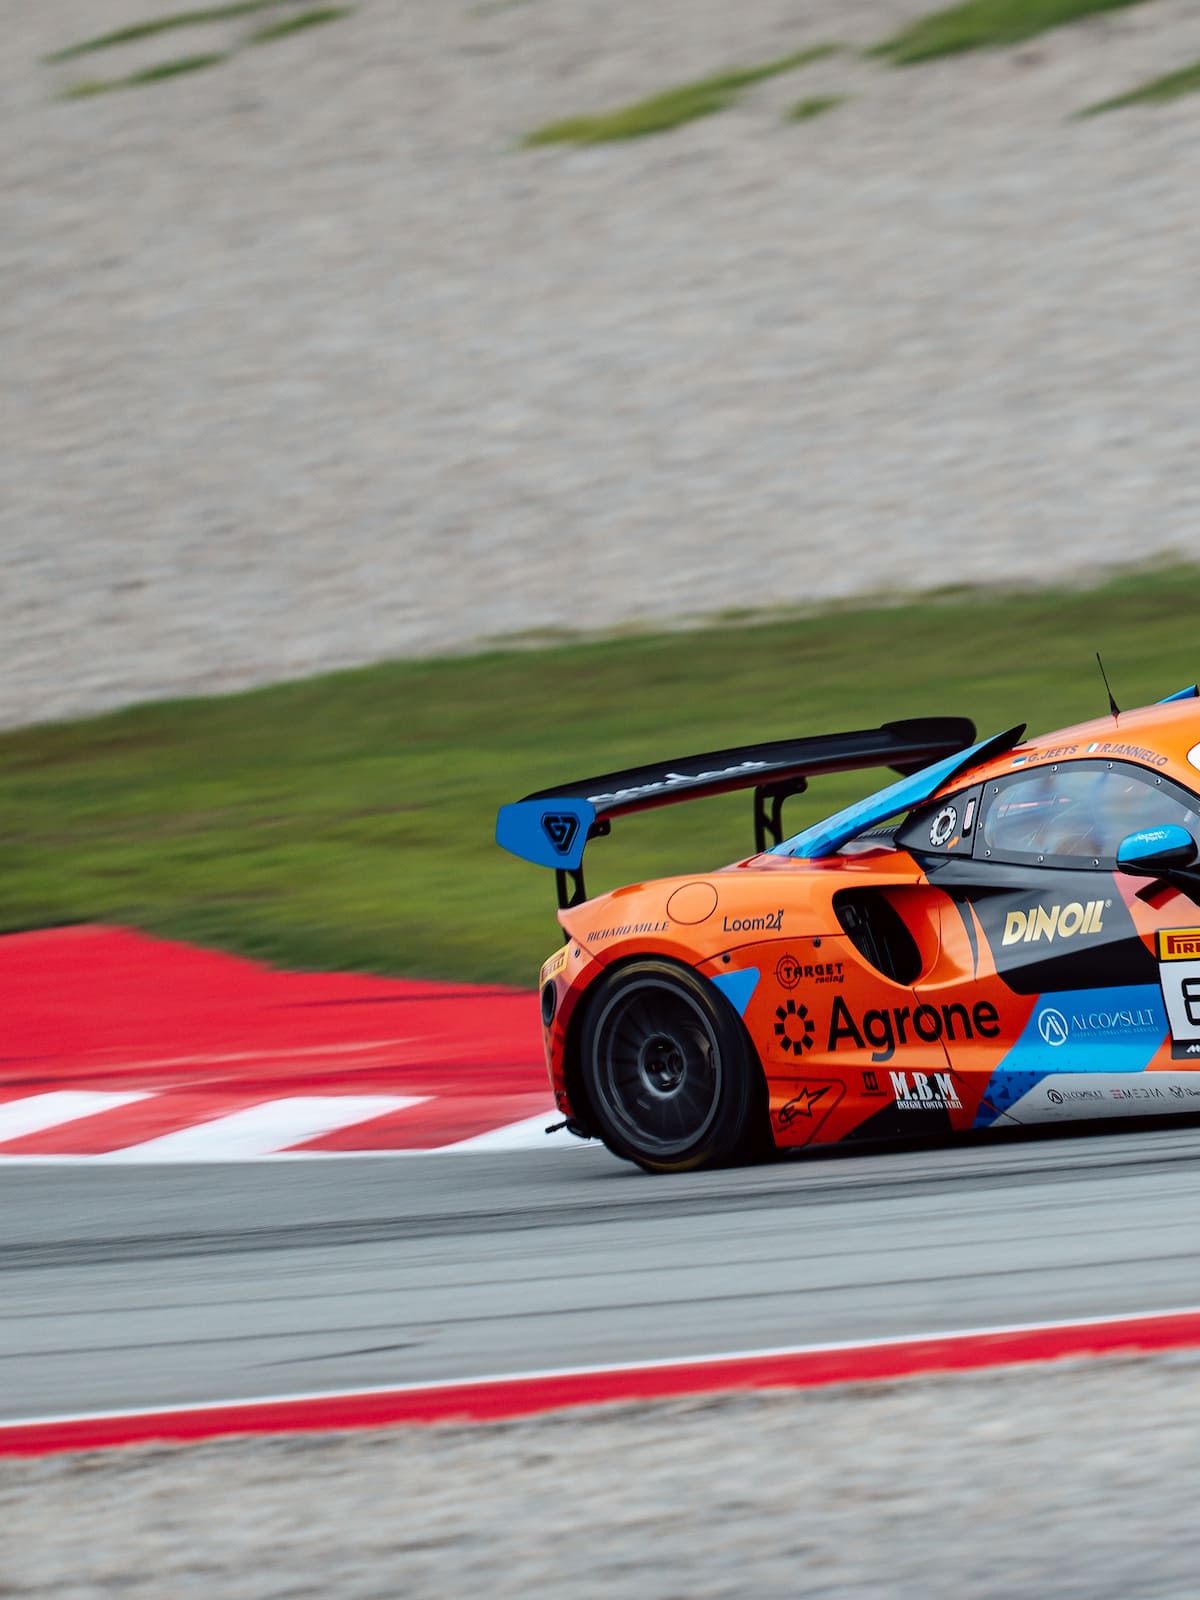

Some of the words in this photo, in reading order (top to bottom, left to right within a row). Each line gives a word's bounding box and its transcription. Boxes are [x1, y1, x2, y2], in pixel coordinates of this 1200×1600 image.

[1028, 745, 1078, 763] G.JEETS
[1100, 743, 1168, 767] R.IANNIELLO
[723, 909, 784, 932] Loom24
[1002, 900, 1105, 946] DINOIL
[586, 925, 631, 943] RICHARD
[633, 921, 669, 933] MILLE
[783, 963, 844, 979] TARGET
[815, 975, 845, 984] racing
[827, 995, 1001, 1062] Agrone
